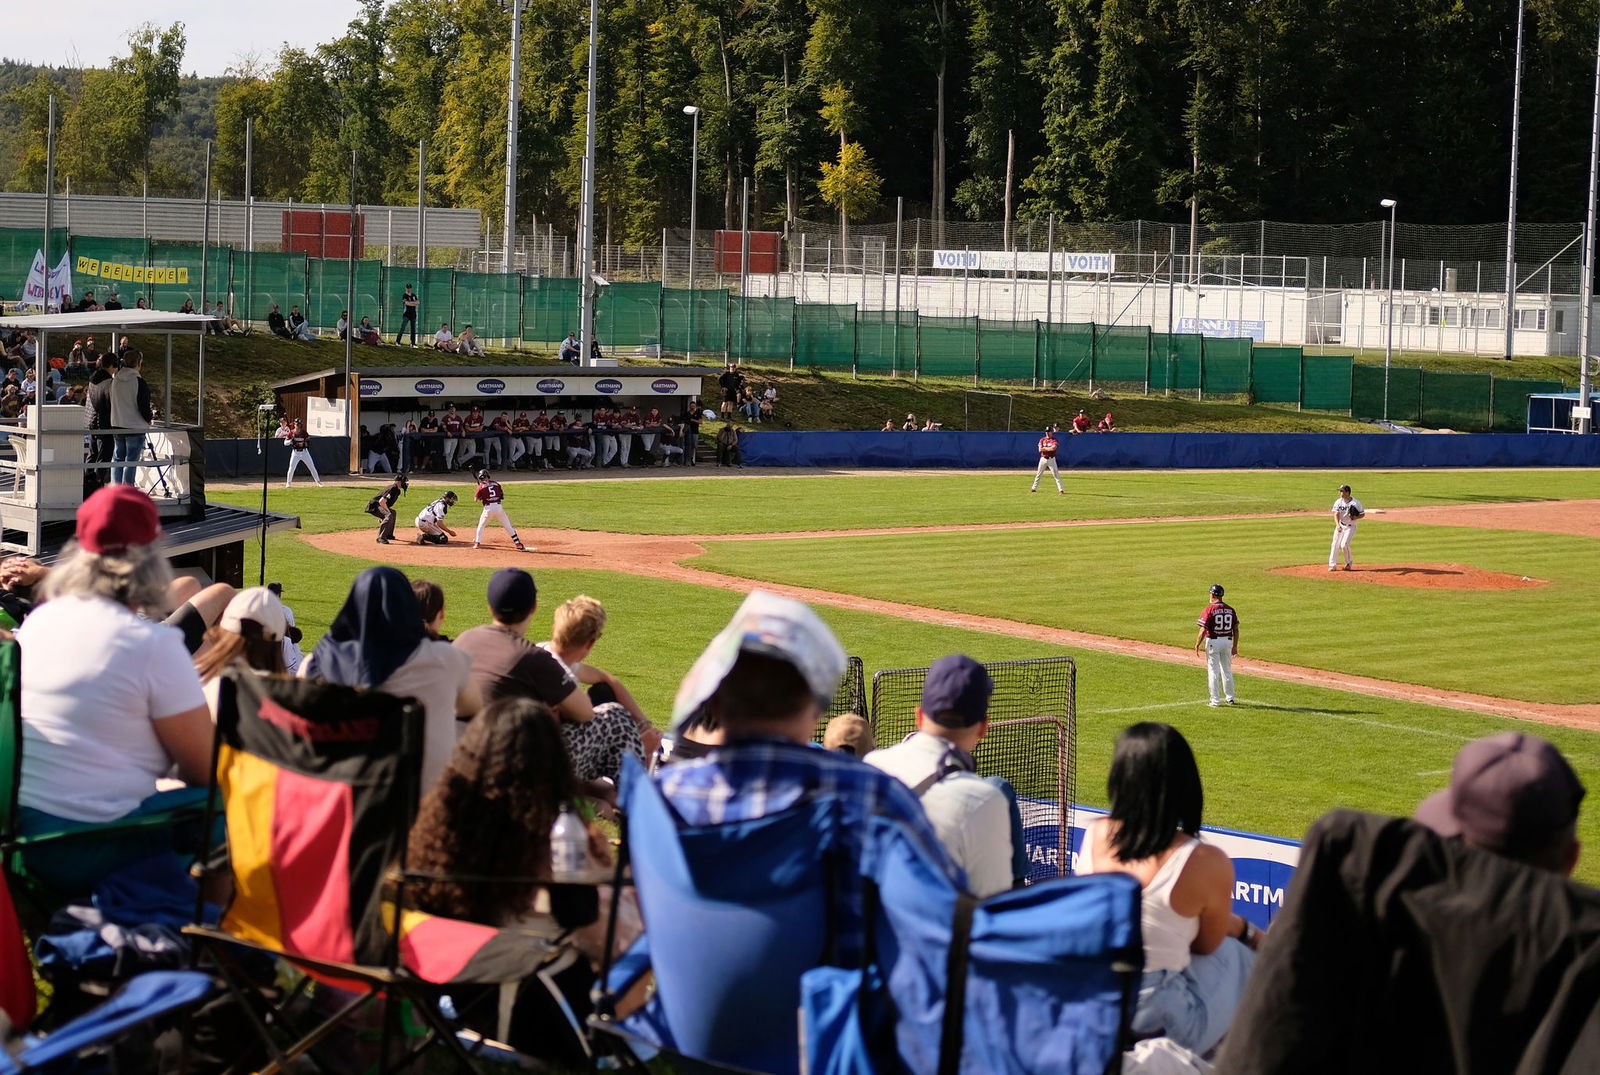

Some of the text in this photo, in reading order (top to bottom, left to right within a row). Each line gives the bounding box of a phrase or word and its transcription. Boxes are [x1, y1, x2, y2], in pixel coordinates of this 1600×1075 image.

[938, 253, 977, 266] VOITH
[1068, 255, 1111, 270] VOITH
[78, 261, 96, 271] WE
[104, 264, 174, 279] BELIEVE
[488, 486, 496, 497] 5
[1214, 614, 1233, 630] 99
